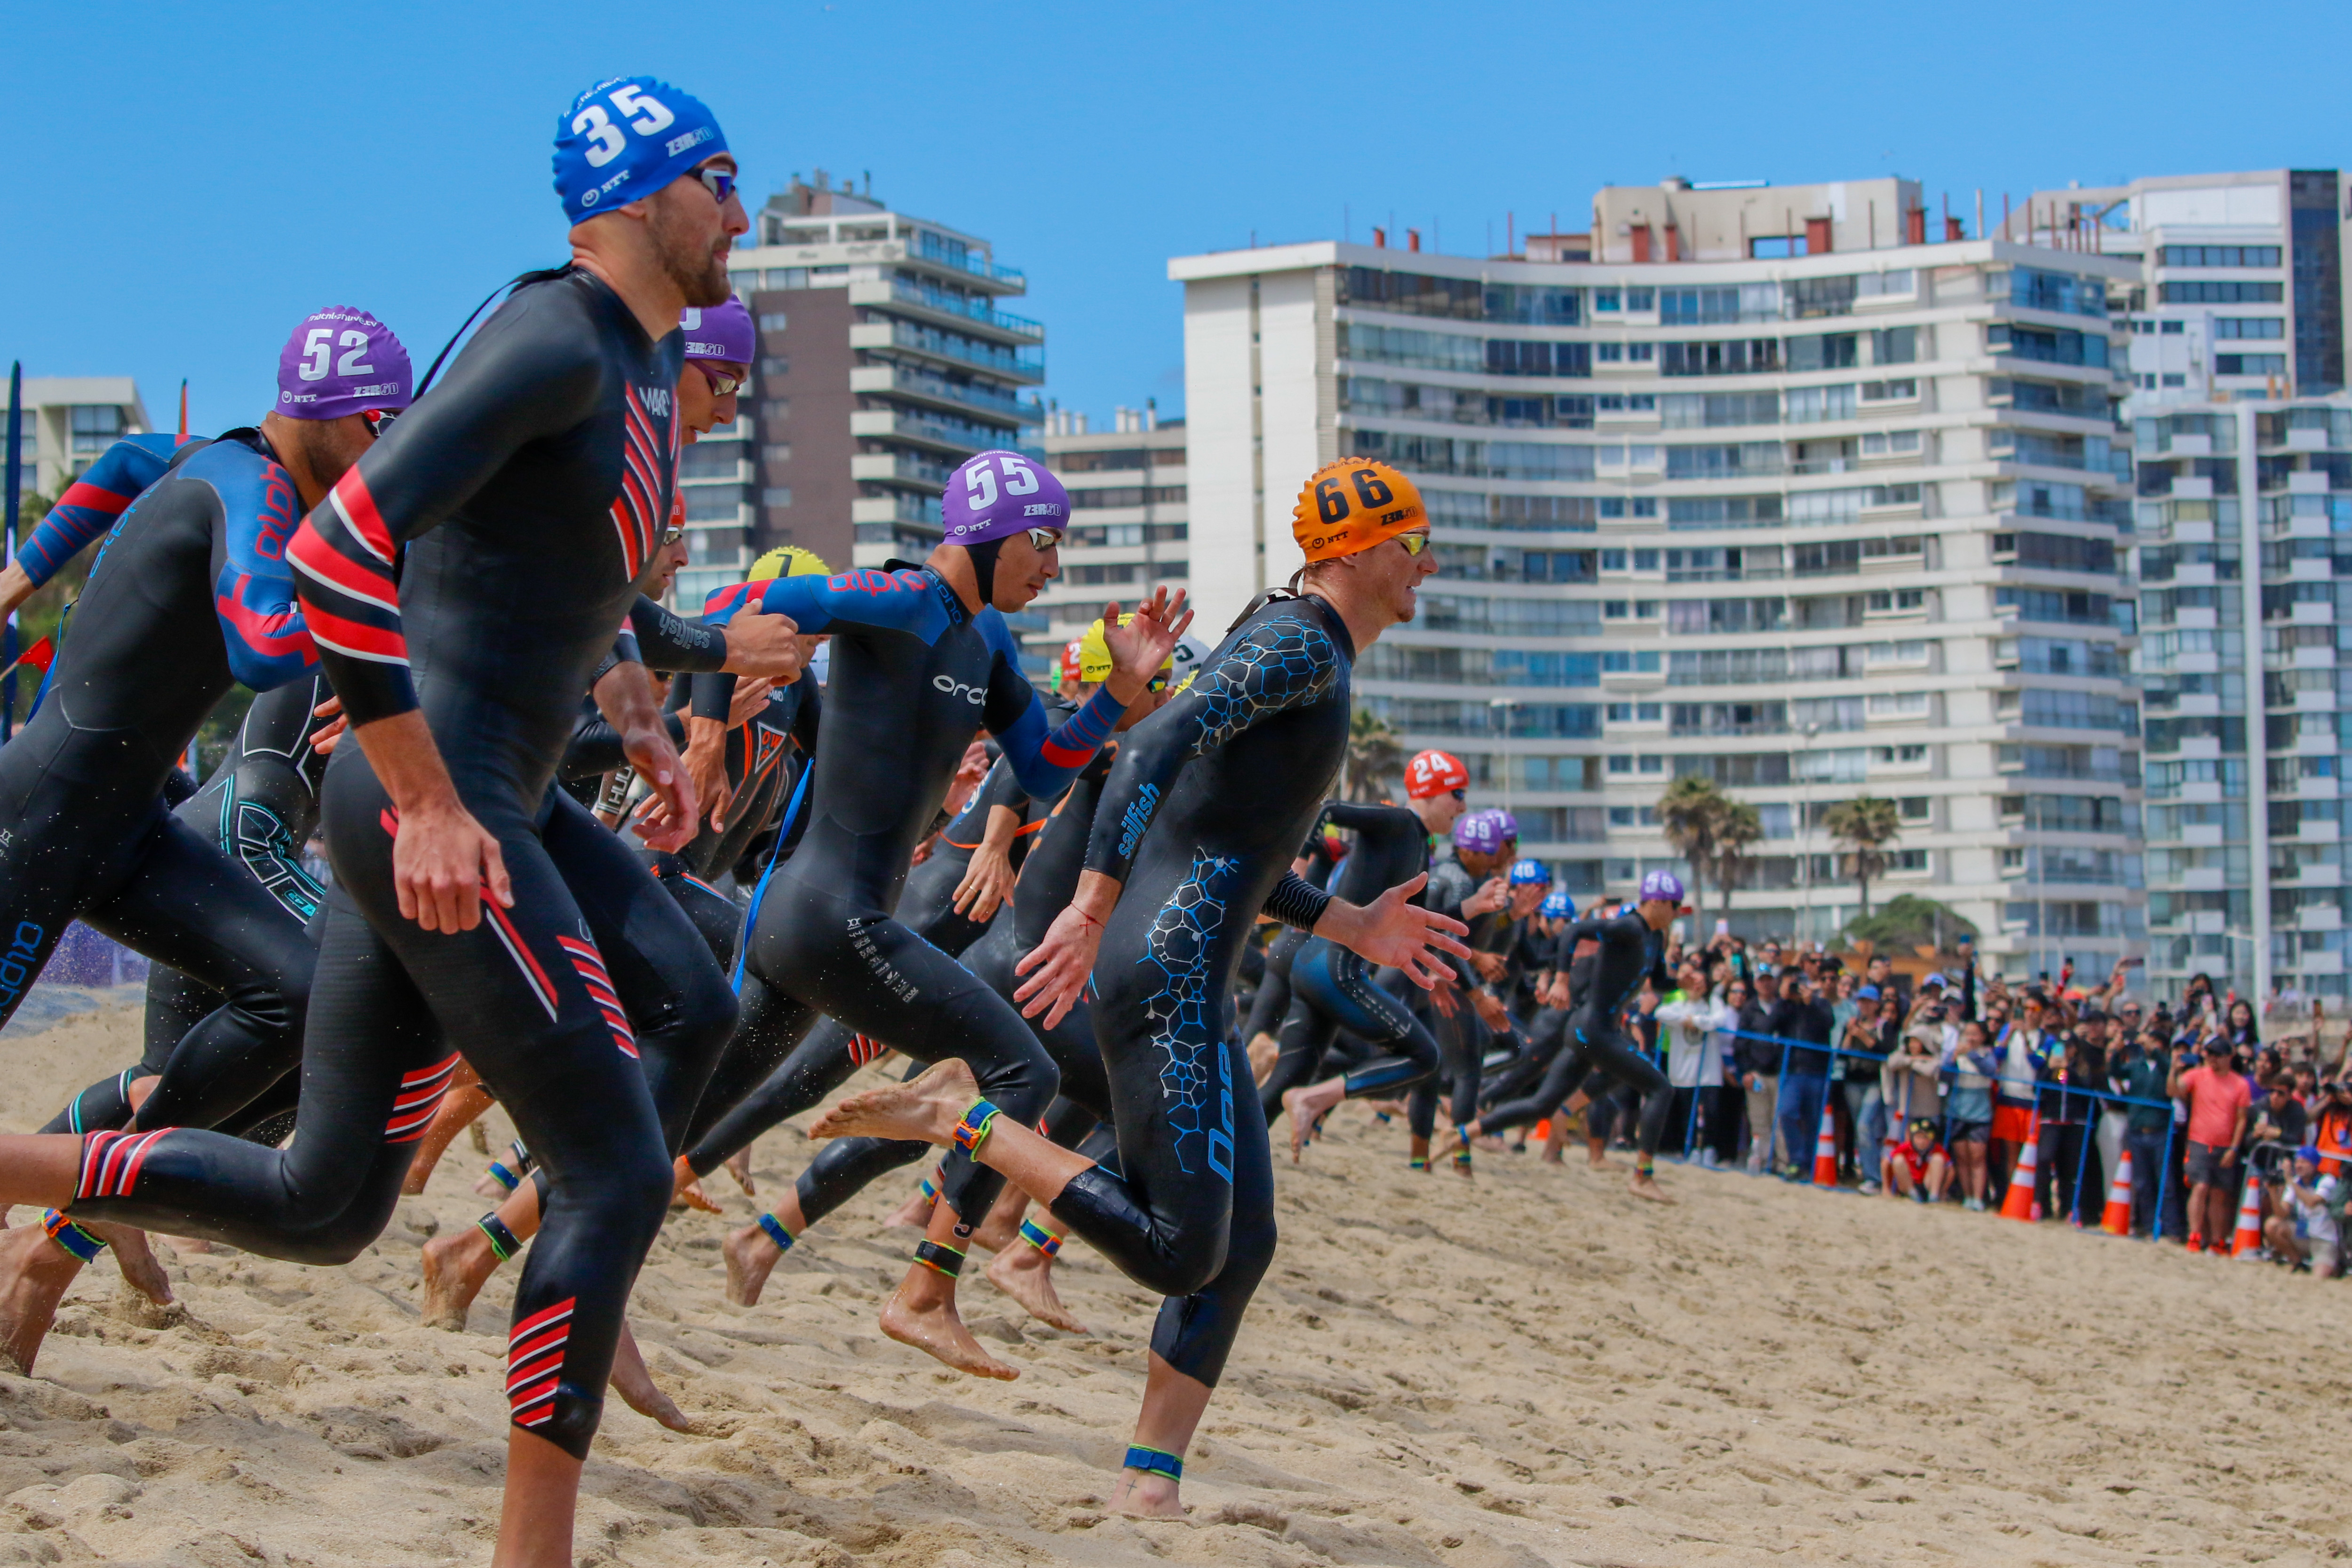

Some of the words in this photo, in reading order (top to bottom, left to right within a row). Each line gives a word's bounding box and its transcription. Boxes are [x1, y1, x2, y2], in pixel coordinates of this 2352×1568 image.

[572, 84, 675, 168] 35
[601, 169, 631, 193] NTT
[299, 329, 374, 381] 52
[294, 394, 317, 404] NTT
[965, 457, 1040, 511] 55
[1315, 469, 1394, 524] 66
[969, 519, 992, 532] NTT
[1327, 531, 1348, 544] NTT
[659, 612, 711, 649] sailfish
[1413, 753, 1453, 784] 24
[1118, 783, 1160, 860] sailfish
[1464, 818, 1491, 840] 59
